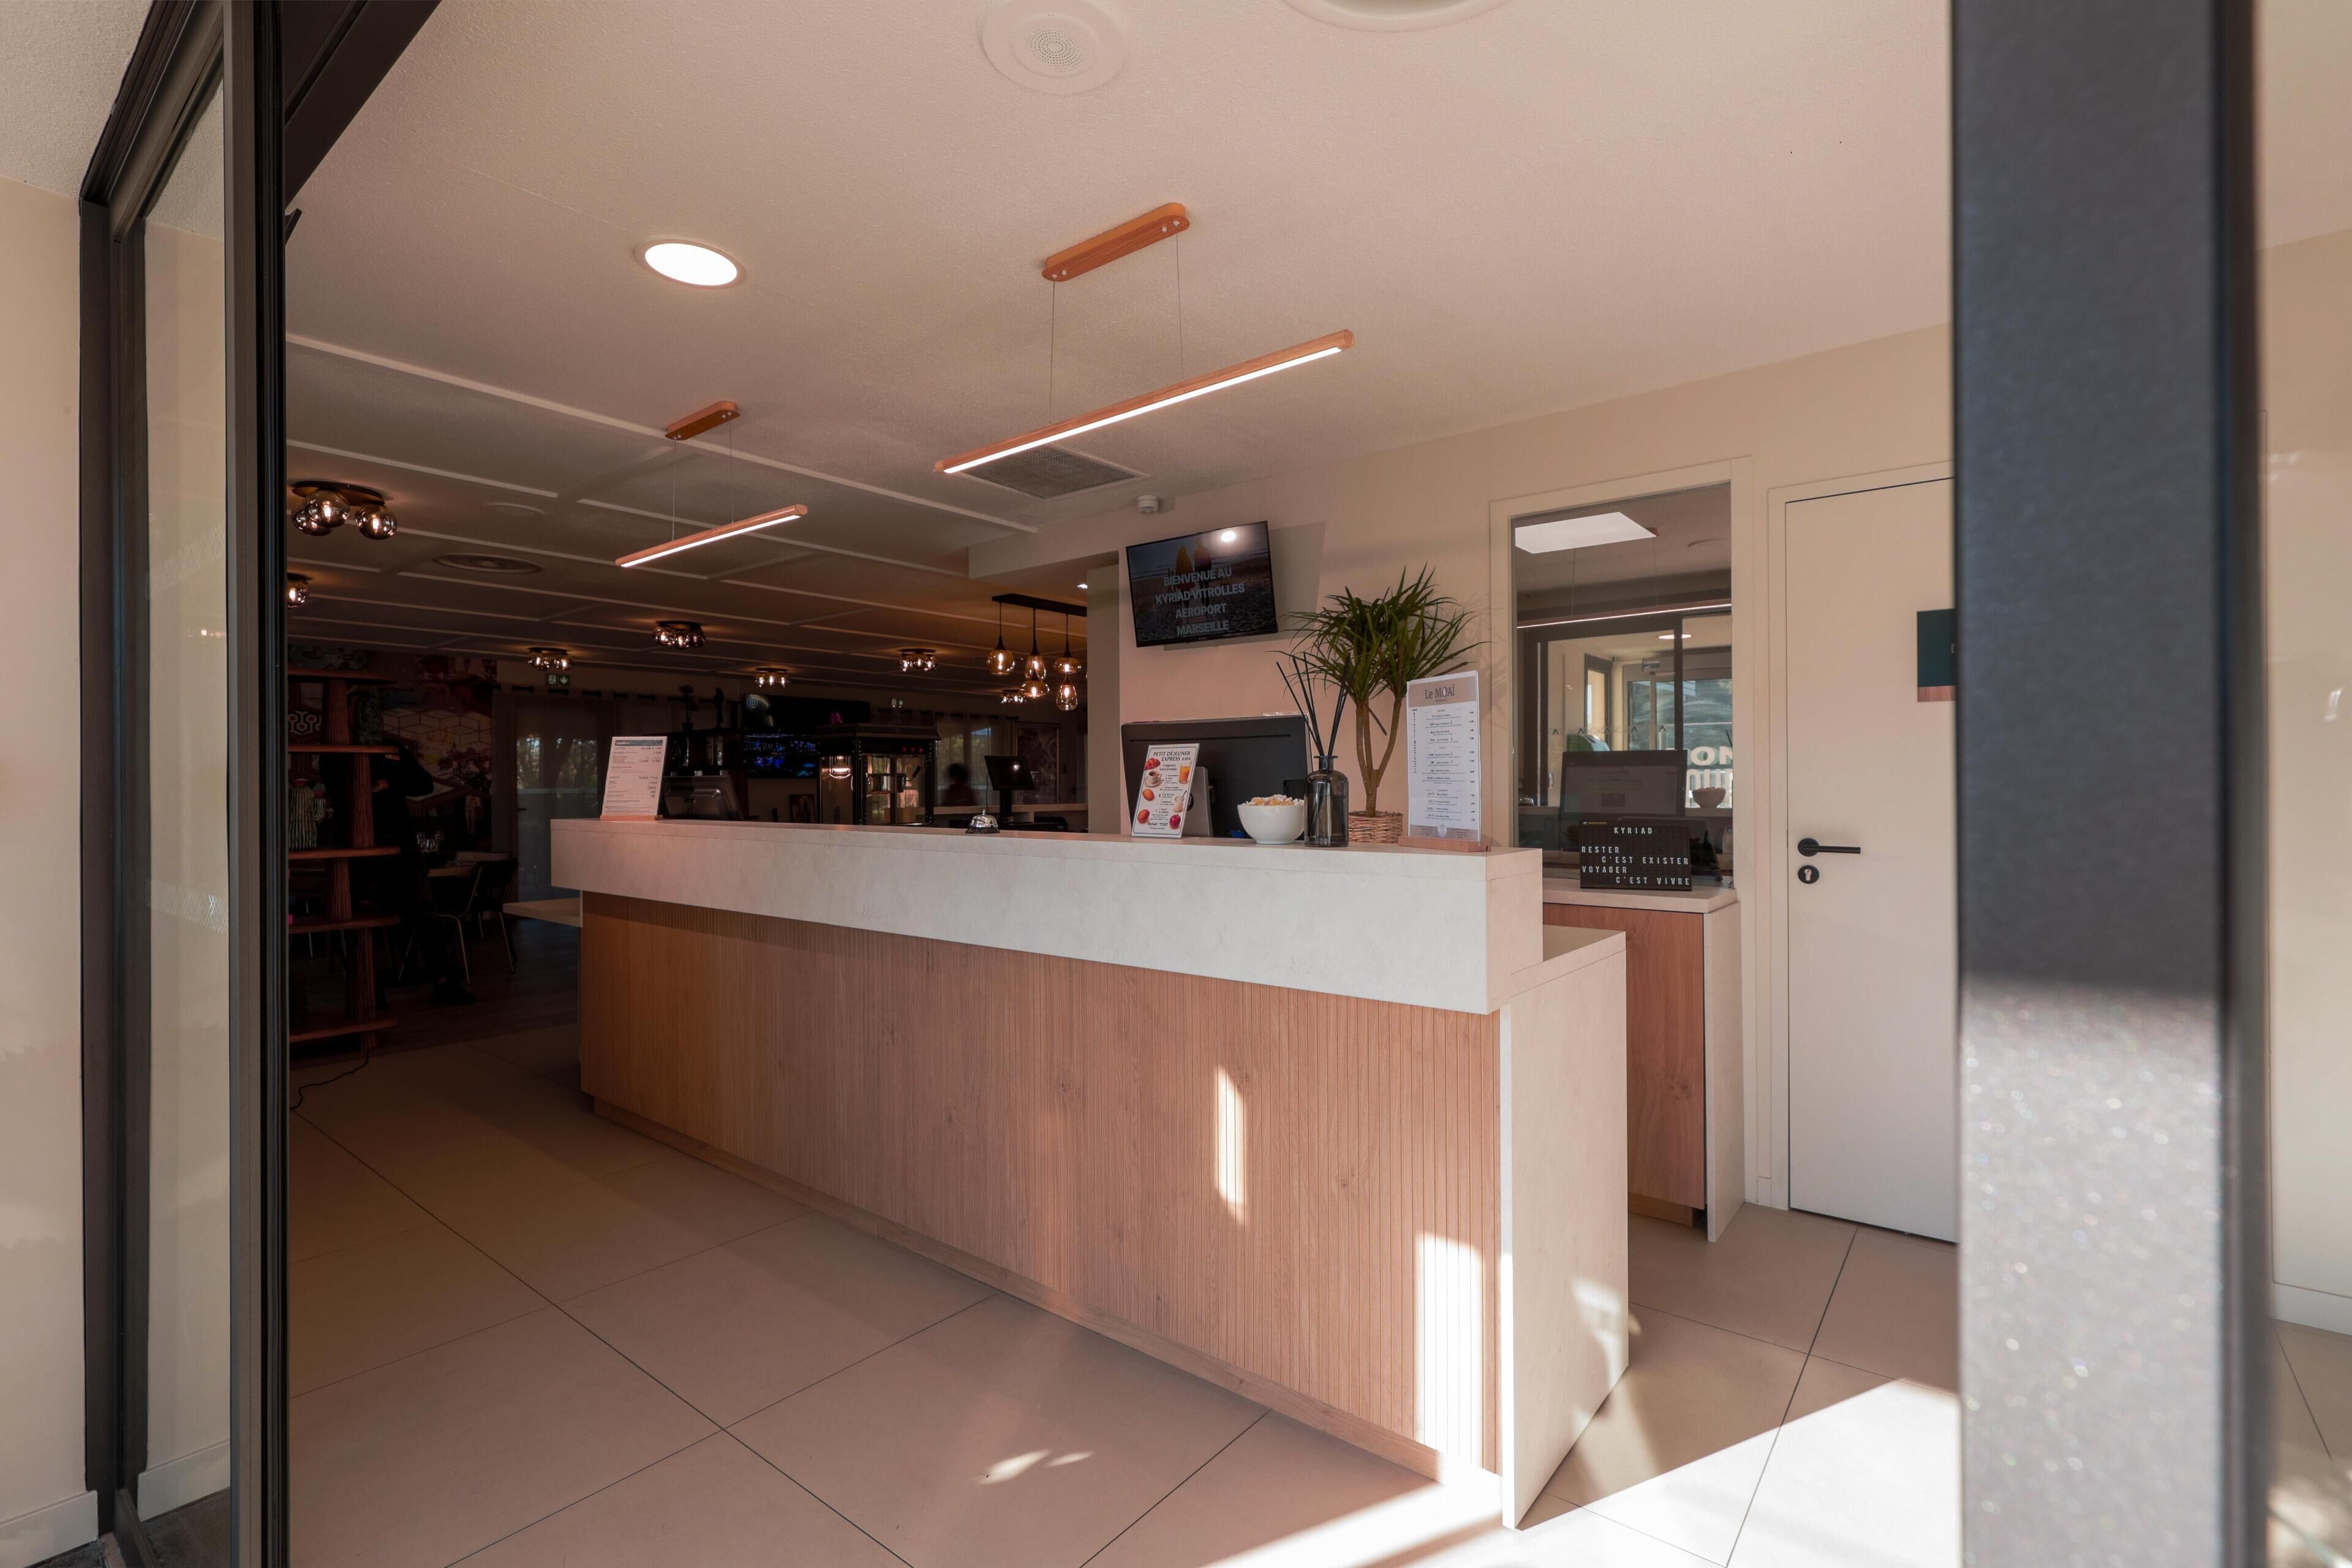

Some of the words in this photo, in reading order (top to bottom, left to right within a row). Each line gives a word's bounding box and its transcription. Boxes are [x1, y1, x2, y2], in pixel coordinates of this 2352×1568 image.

[1164, 570, 1216, 586] BIENVENUE
[1218, 567, 1232, 578] AU
[1156, 590, 1191, 605] KYRIAD
[1192, 583, 1245, 598] VITROLLES
[1175, 603, 1227, 619] AEROPORT
[1176, 620, 1229, 636] MARSEILLE
[1425, 689, 1433, 699] Le
[1435, 684, 1455, 698] MOAÏ
